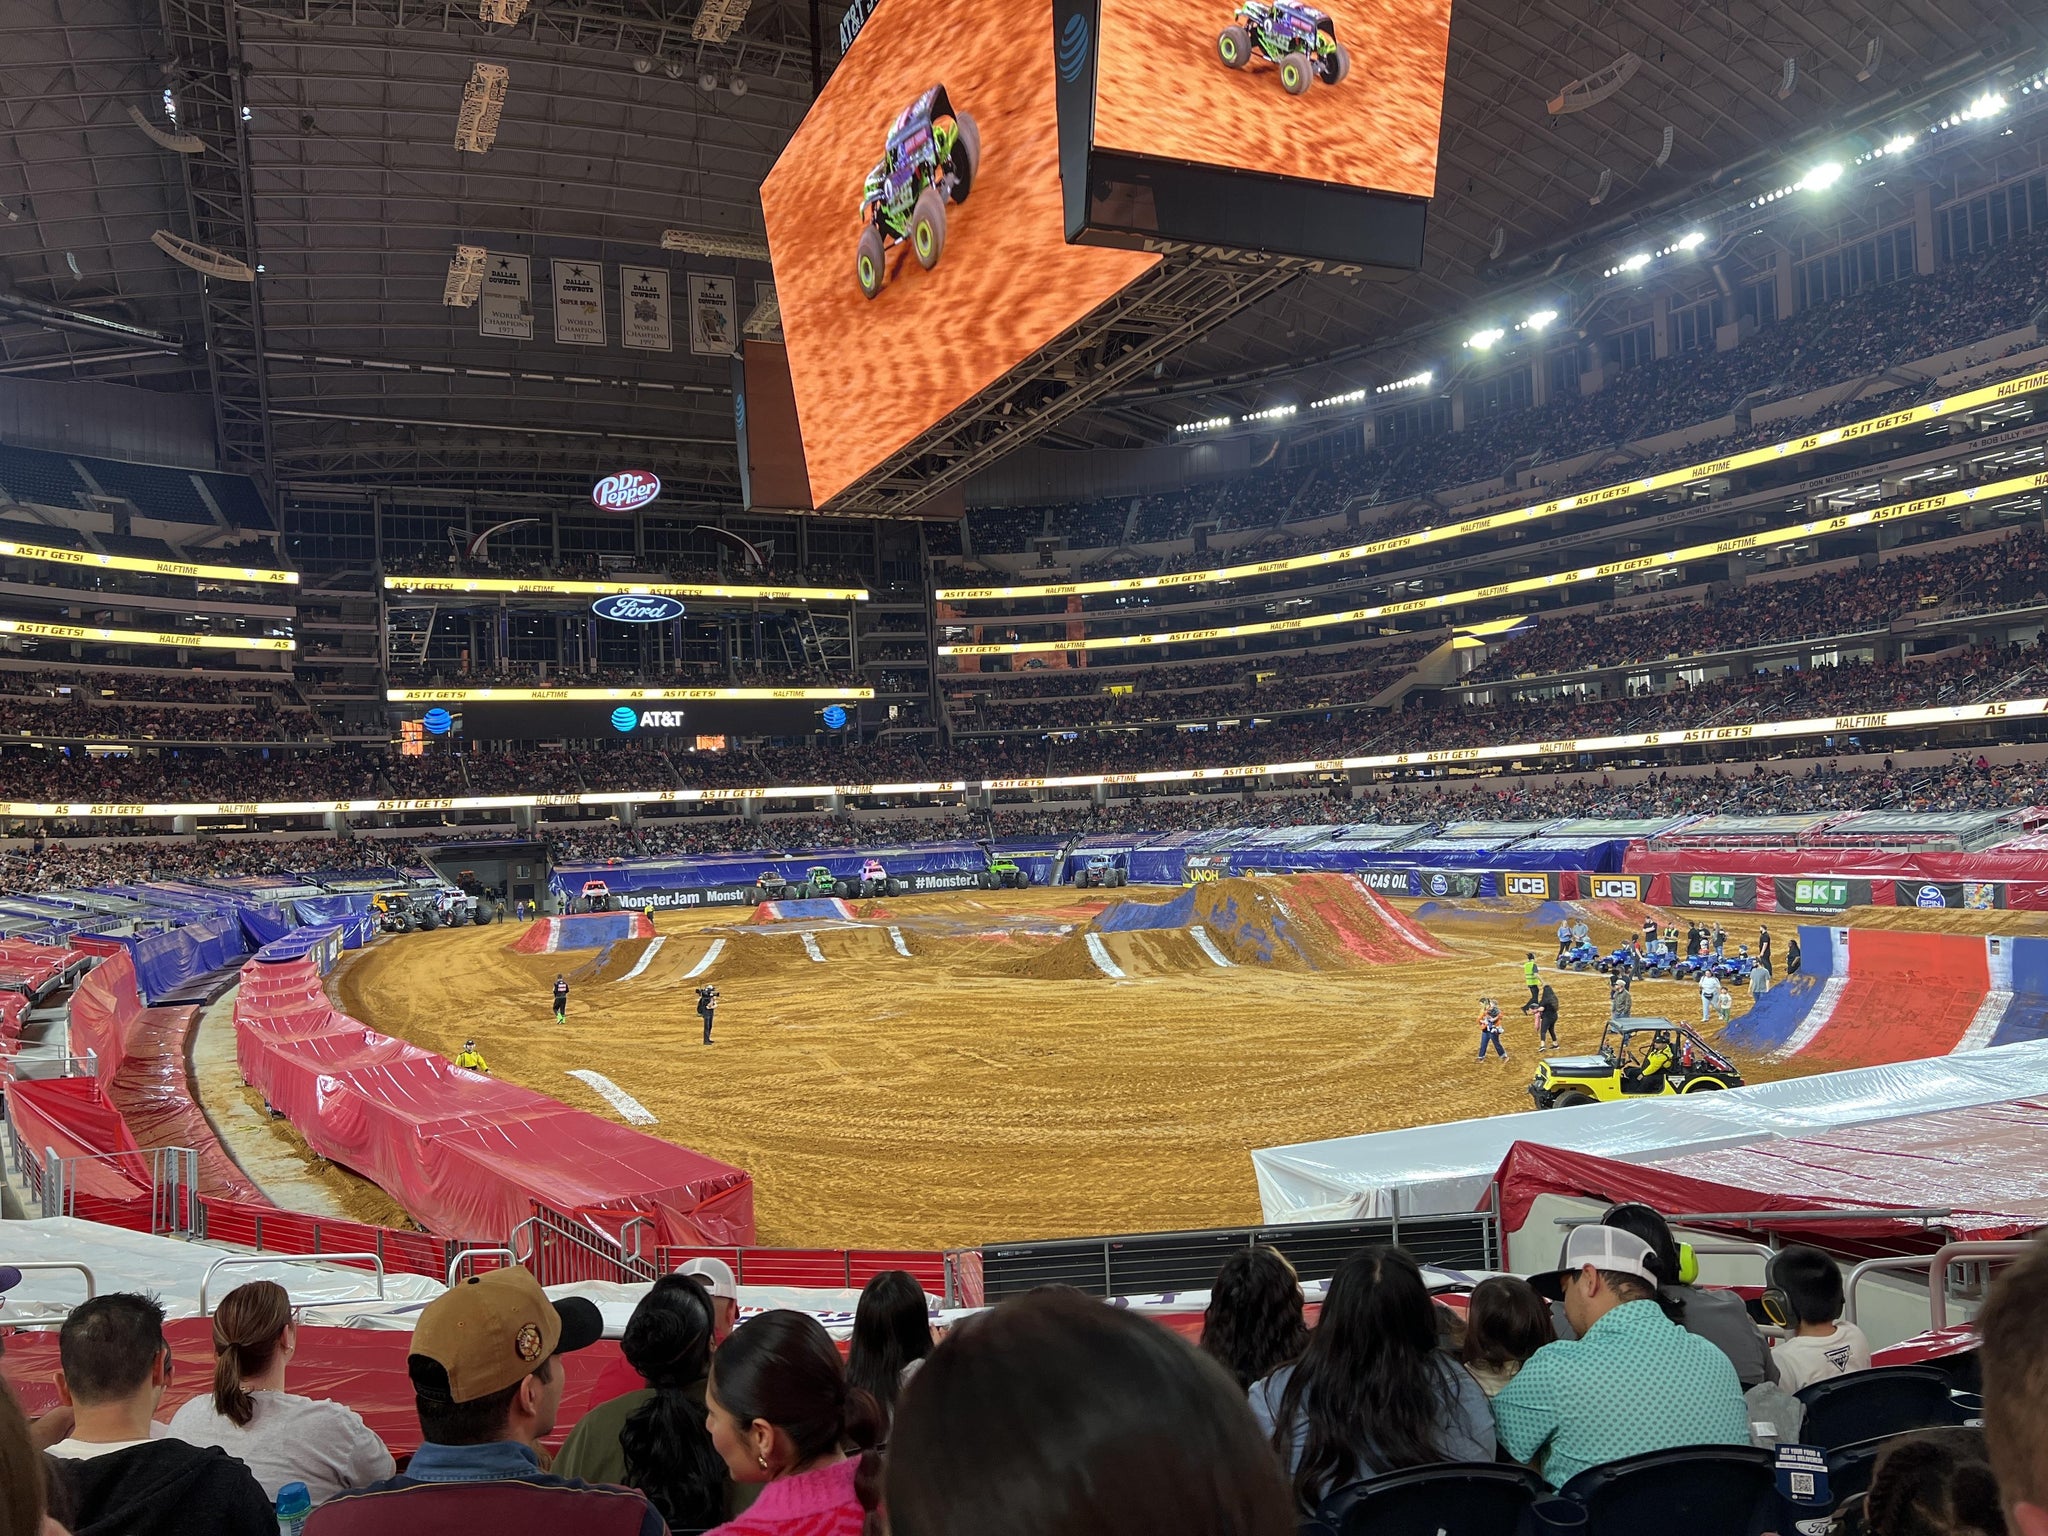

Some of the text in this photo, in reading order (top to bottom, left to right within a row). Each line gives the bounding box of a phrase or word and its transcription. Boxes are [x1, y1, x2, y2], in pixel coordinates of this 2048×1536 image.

[840, 0, 864, 55] AT&T
[1143, 239, 1363, 277] WINSTAR
[489, 277, 520, 285] COWBOYS
[563, 285, 593, 293] COWBOYS
[631, 291, 660, 299] COWBOYS
[560, 298, 578, 306] SUPER
[492, 311, 520, 319] WORLD
[484, 319, 528, 328] CHAMPIONS
[567, 318, 593, 326] WORLD
[633, 323, 659, 332] WORLD
[560, 325, 602, 334] CHAMPIONS
[626, 331, 667, 340] CHAMPIONS
[640, 338, 655, 346] 1992
[1997, 376, 2048, 398] HALFTIME
[1800, 412, 1913, 449] AS AS IT GETS!
[1968, 431, 2020, 450] 74 BOB LILLY
[1692, 460, 1731, 477] HALFTIME
[618, 473, 643, 491] Dr
[1809, 479, 1824, 488] DON
[1825, 471, 1860, 483] MEREDITH
[593, 476, 656, 507] Pepper
[1545, 486, 1630, 512] AS AS IT GETS!
[1829, 496, 1946, 528] AS AS IT GETS!
[1460, 519, 1491, 533] HALFTIME
[1366, 545, 1378, 553] AS
[1377, 543, 1386, 551] IT
[1387, 538, 1410, 549] GETS!
[1716, 537, 1757, 552] HALFTIME
[17, 547, 84, 562] AS IT GETS!
[157, 563, 198, 575] HALFTIME
[1258, 562, 1289, 573] HALFTIME
[1565, 557, 1653, 581] AS AS IT GETS!
[270, 573, 285, 581] AS
[1158, 577, 1170, 585] AS
[1181, 574, 1206, 582] GETS!
[518, 584, 555, 592] HALFTIME
[1045, 586, 1076, 594] HALFTIME
[1477, 585, 1509, 598] HALFTIME
[609, 597, 668, 618] Ford
[1353, 600, 1427, 619] AS AS IT GETS!
[16, 624, 84, 637] AS IT GETS!
[1270, 620, 1301, 630] HALFTIME
[159, 634, 201, 646] HALFTIME
[1169, 633, 1182, 641] AS
[1181, 632, 1191, 640] IT
[1192, 631, 1218, 639] GETS!
[273, 641, 289, 649] AS
[1055, 642, 1086, 650] HALFTIME
[406, 691, 467, 699] AS IT GETS!
[531, 691, 569, 699] HALFTIME
[630, 690, 716, 698] AS AS IT GETS!
[773, 690, 805, 698] HALFTIME
[1984, 704, 2007, 716] AS
[640, 711, 684, 727] AT&T
[1836, 714, 1888, 730] HALFTIME
[1644, 726, 1753, 744] AS AS IT GETS!
[1539, 742, 1576, 753] HALFTIME
[1397, 750, 1479, 764] AS AS IT GETS!
[1315, 761, 1344, 770] HALFTIME
[1223, 768, 1236, 776] AS
[991, 779, 1045, 788] AS IT GETS!
[1103, 774, 1137, 783] HALFTIME
[835, 784, 873, 795] HALFTIME
[938, 782, 953, 791] AS
[536, 794, 582, 806] HALFTIME
[659, 788, 765, 800] AS AS IT GETS!
[55, 806, 145, 815] AS AS IT GETS!
[218, 804, 259, 814] HALFTIME
[335, 799, 453, 811] AS AS IT GETS!
[1190, 869, 1219, 882] UNOH
[1359, 873, 1391, 889] LUCAS
[916, 876, 979, 890] #MonsterJ
[1509, 879, 1545, 894] JCB
[1595, 881, 1637, 897] JCB
[1690, 879, 1734, 895] BKT
[1797, 884, 1846, 901] BKT
